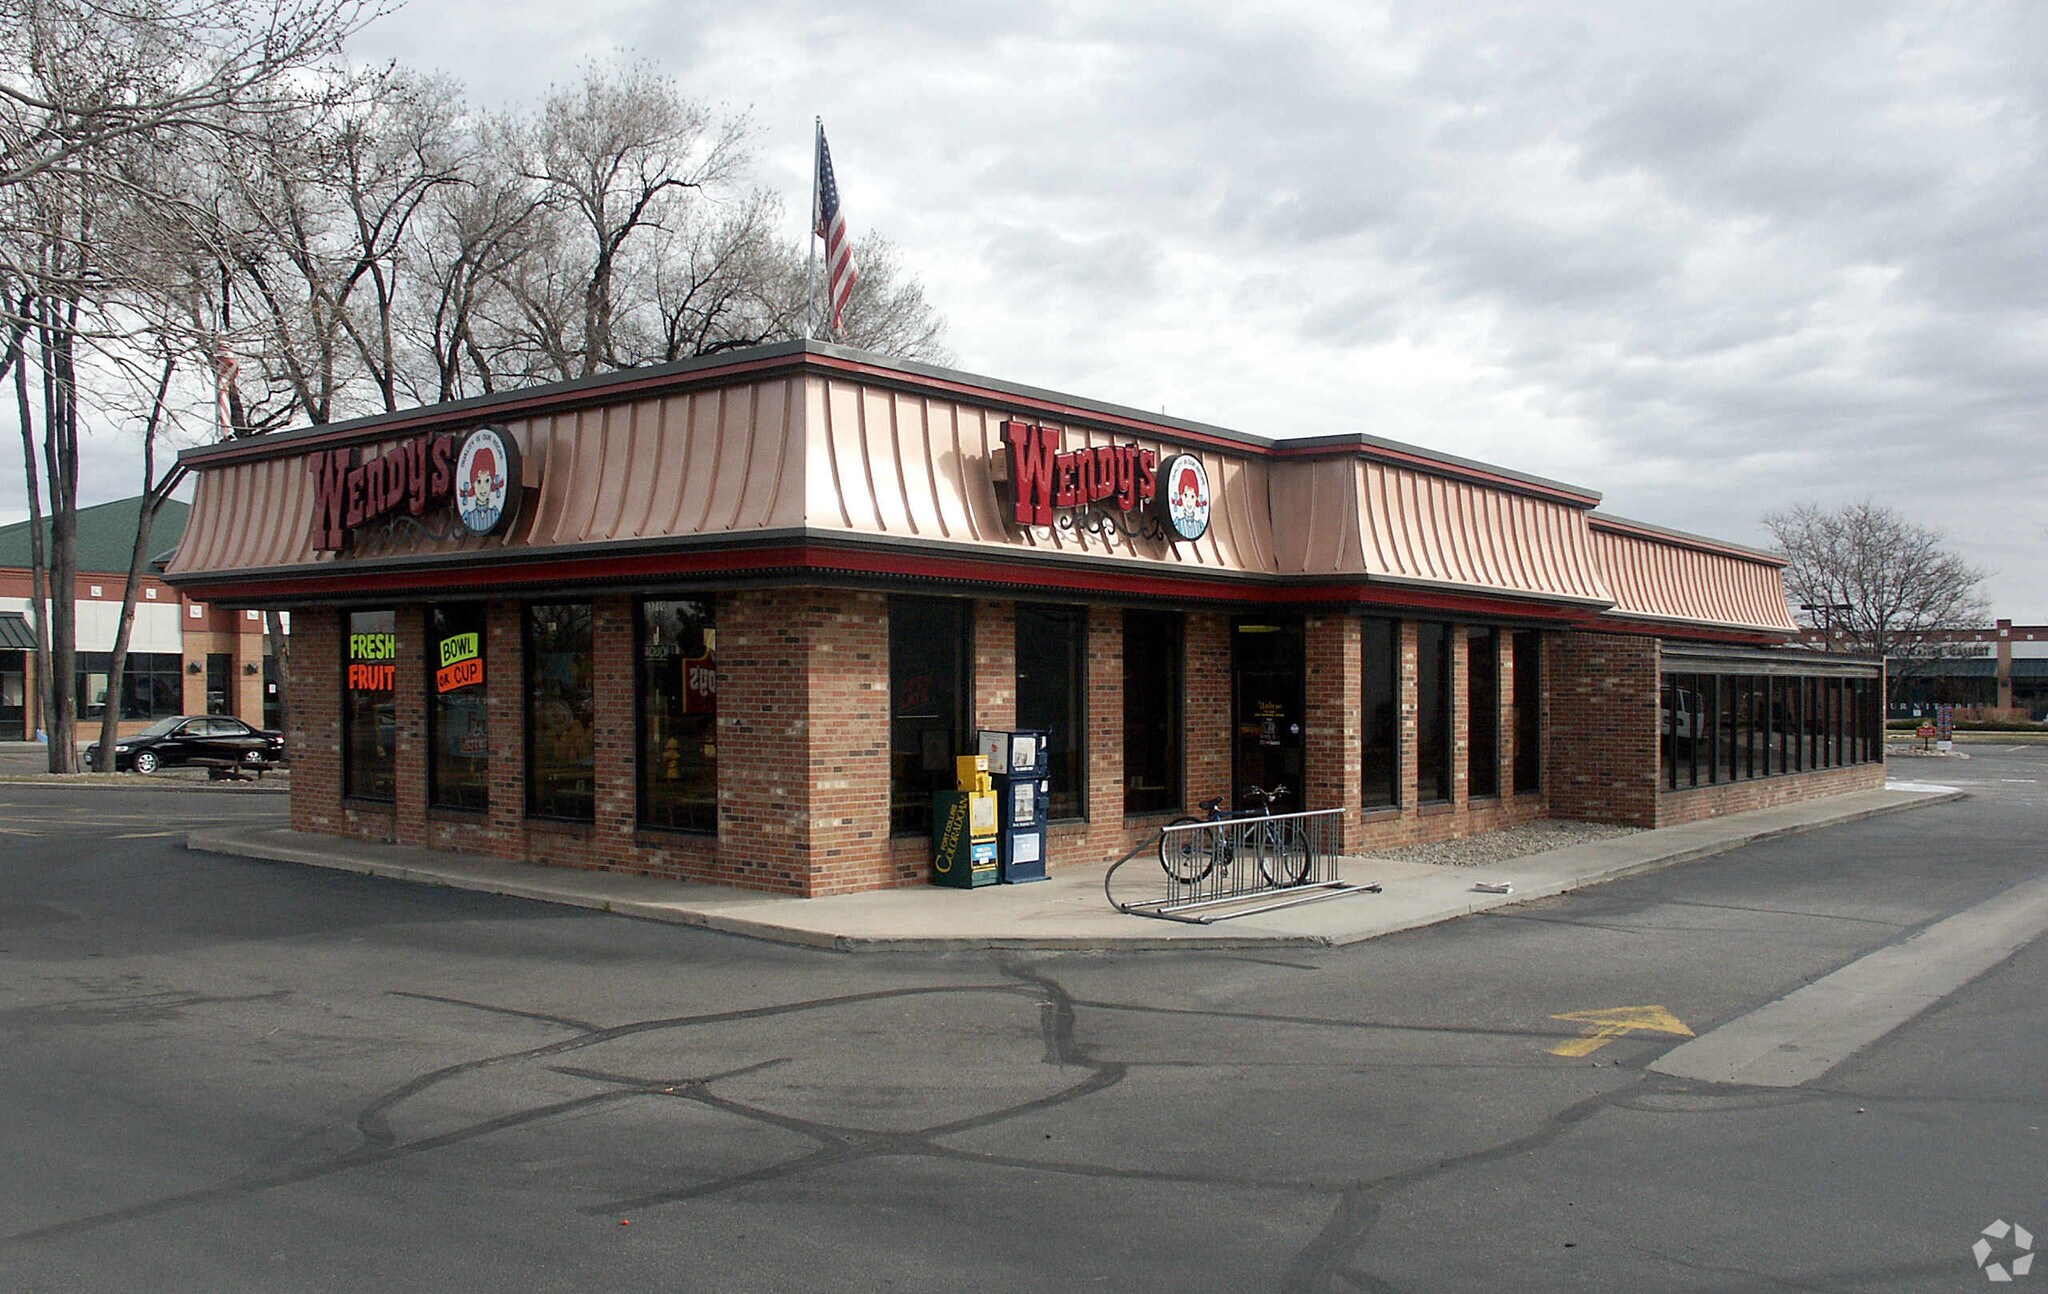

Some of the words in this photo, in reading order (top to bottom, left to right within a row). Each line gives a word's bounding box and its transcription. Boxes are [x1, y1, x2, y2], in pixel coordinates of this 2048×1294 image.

[1007, 421, 1157, 526] Wendy's
[309, 432, 455, 551] Wendy's
[350, 633, 396, 660] FRESH
[443, 637, 474, 662] BOWL
[348, 664, 396, 692] FRUIT
[439, 675, 450, 687] OR
[453, 663, 478, 684] CUP
